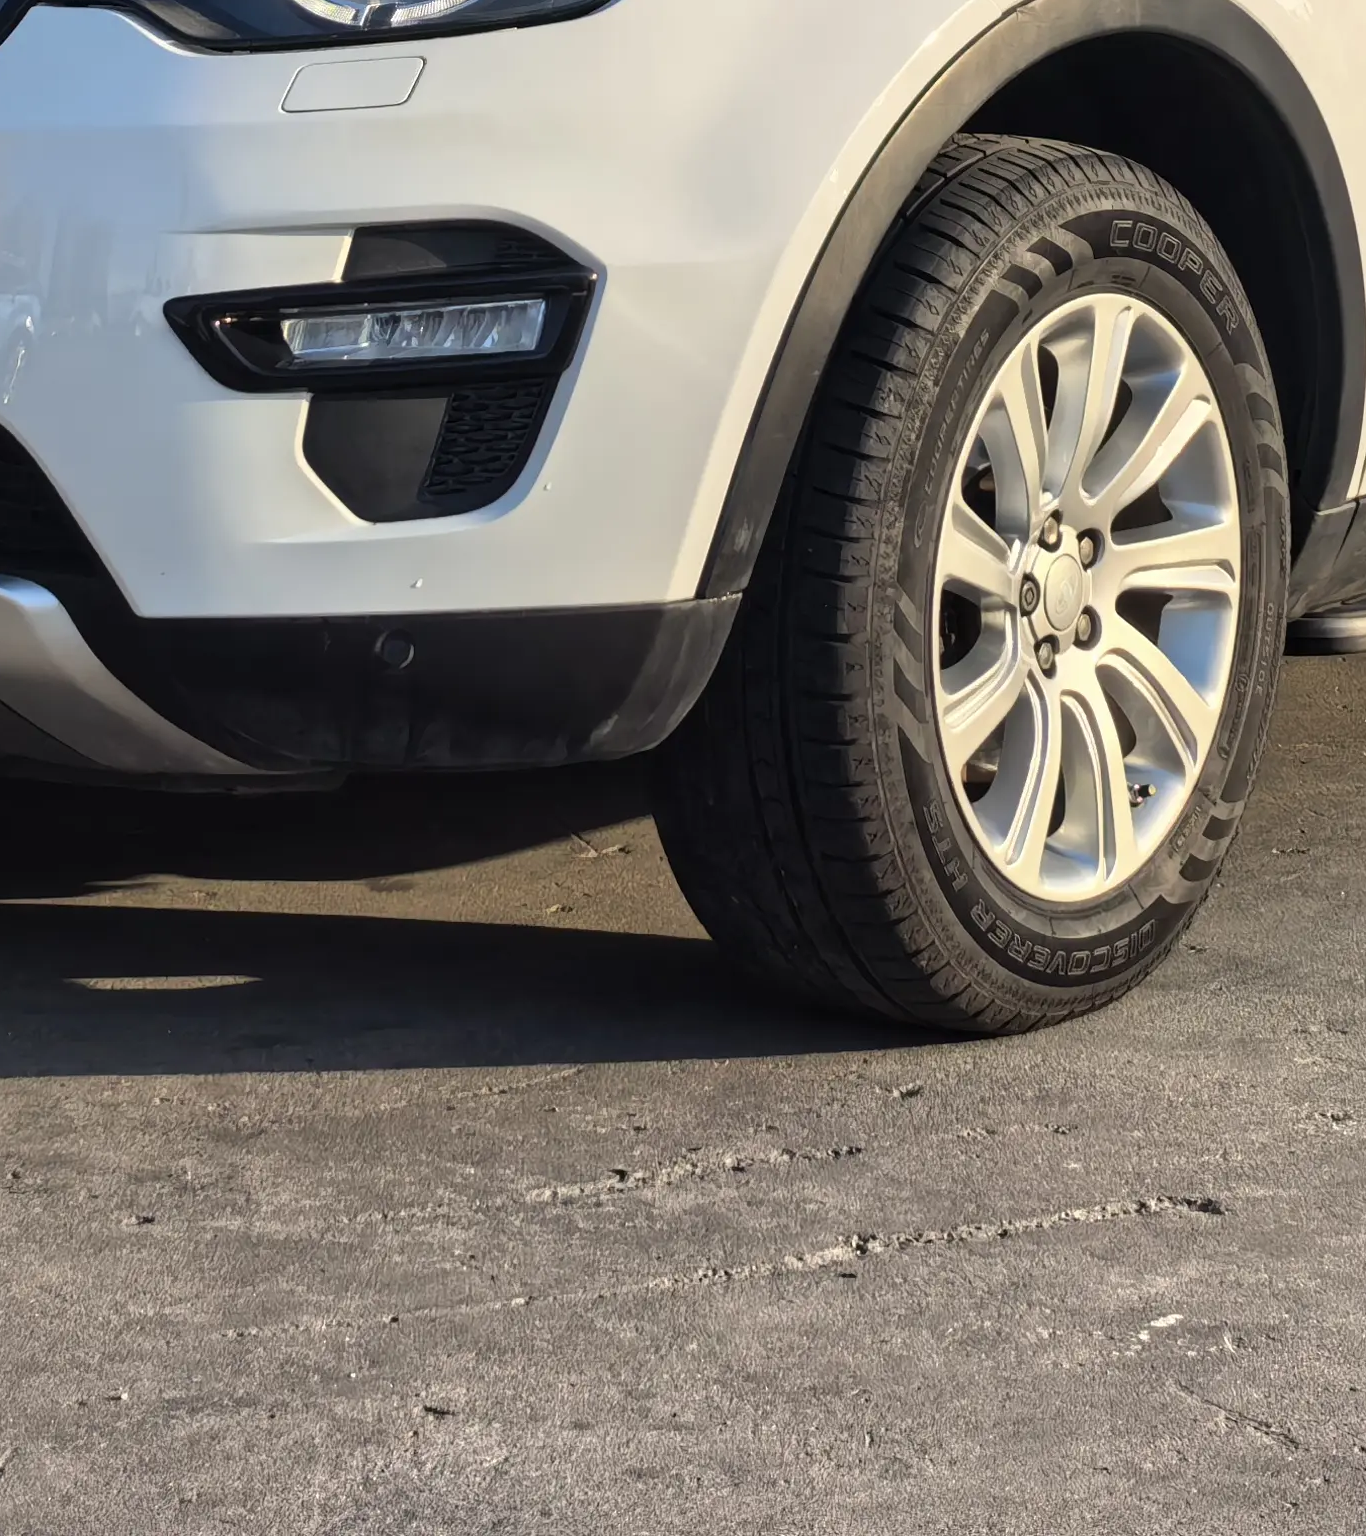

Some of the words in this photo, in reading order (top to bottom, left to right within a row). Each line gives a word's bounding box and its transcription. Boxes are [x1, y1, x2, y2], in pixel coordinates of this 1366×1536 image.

[1109, 219, 1241, 336] COOPER
[922, 798, 969, 892] HTS
[969, 898, 1156, 976] DISCOVERER
